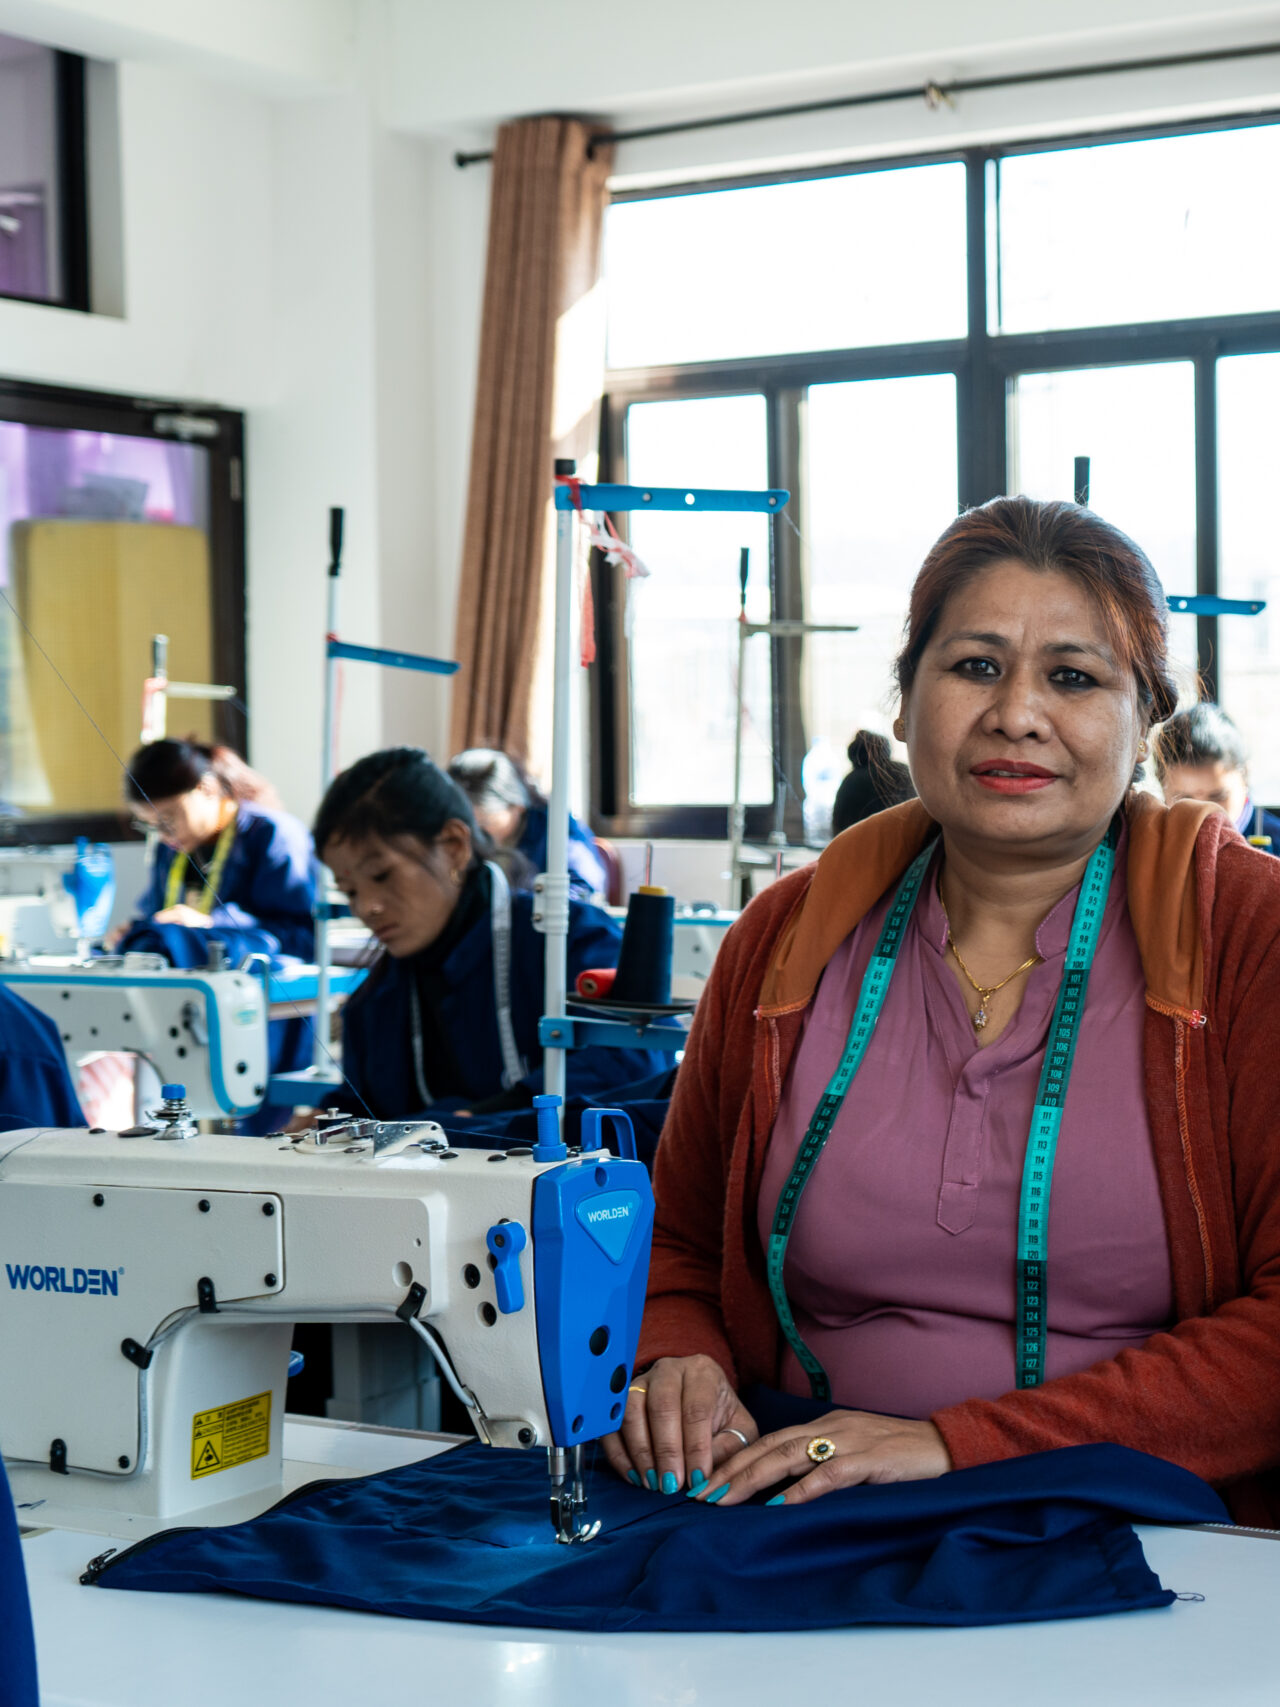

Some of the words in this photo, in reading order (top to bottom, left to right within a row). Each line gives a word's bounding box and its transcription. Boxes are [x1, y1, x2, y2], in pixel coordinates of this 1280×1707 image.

[1097, 859, 1105, 868] 92
[1094, 871, 1103, 880] 93
[1091, 883, 1100, 892] 94
[1088, 896, 1097, 905] 95
[1085, 908, 1095, 917] 96
[1082, 921, 1092, 930] 97
[1080, 935, 1089, 943] 98
[1076, 948, 1086, 956] 99
[1071, 974, 1081, 983] 101
[1067, 988, 1079, 996] 102
[1064, 1001, 1076, 1010] 103
[1061, 1015, 1073, 1023] 104
[1059, 1028, 1071, 1037] 105
[1056, 1042, 1069, 1051] 106
[1053, 1056, 1065, 1065] 107
[1050, 1070, 1063, 1079] 108
[1047, 1083, 1060, 1092] 109
[1044, 1097, 1057, 1106] 110
[1043, 1112, 1052, 1120] 111
[1040, 1126, 1050, 1135] 112
[1038, 1141, 1048, 1150] 113
[1035, 1156, 1045, 1164] 114
[1033, 1171, 1043, 1180] 115
[1031, 1187, 1042, 1196] 116
[1030, 1203, 1040, 1211] 117
[587, 1206, 629, 1223] WORLDEN
[1029, 1219, 1039, 1228] 118
[1028, 1235, 1039, 1244] 119
[1027, 1251, 1039, 1260] 120
[1027, 1266, 1038, 1275] 121
[5, 1264, 119, 1297] WORLDEN
[1027, 1281, 1039, 1290] 122
[1026, 1296, 1039, 1305] 123
[1026, 1311, 1039, 1321] 124
[1026, 1327, 1039, 1336] 125
[1026, 1343, 1039, 1352] 126
[1025, 1359, 1037, 1368] 127
